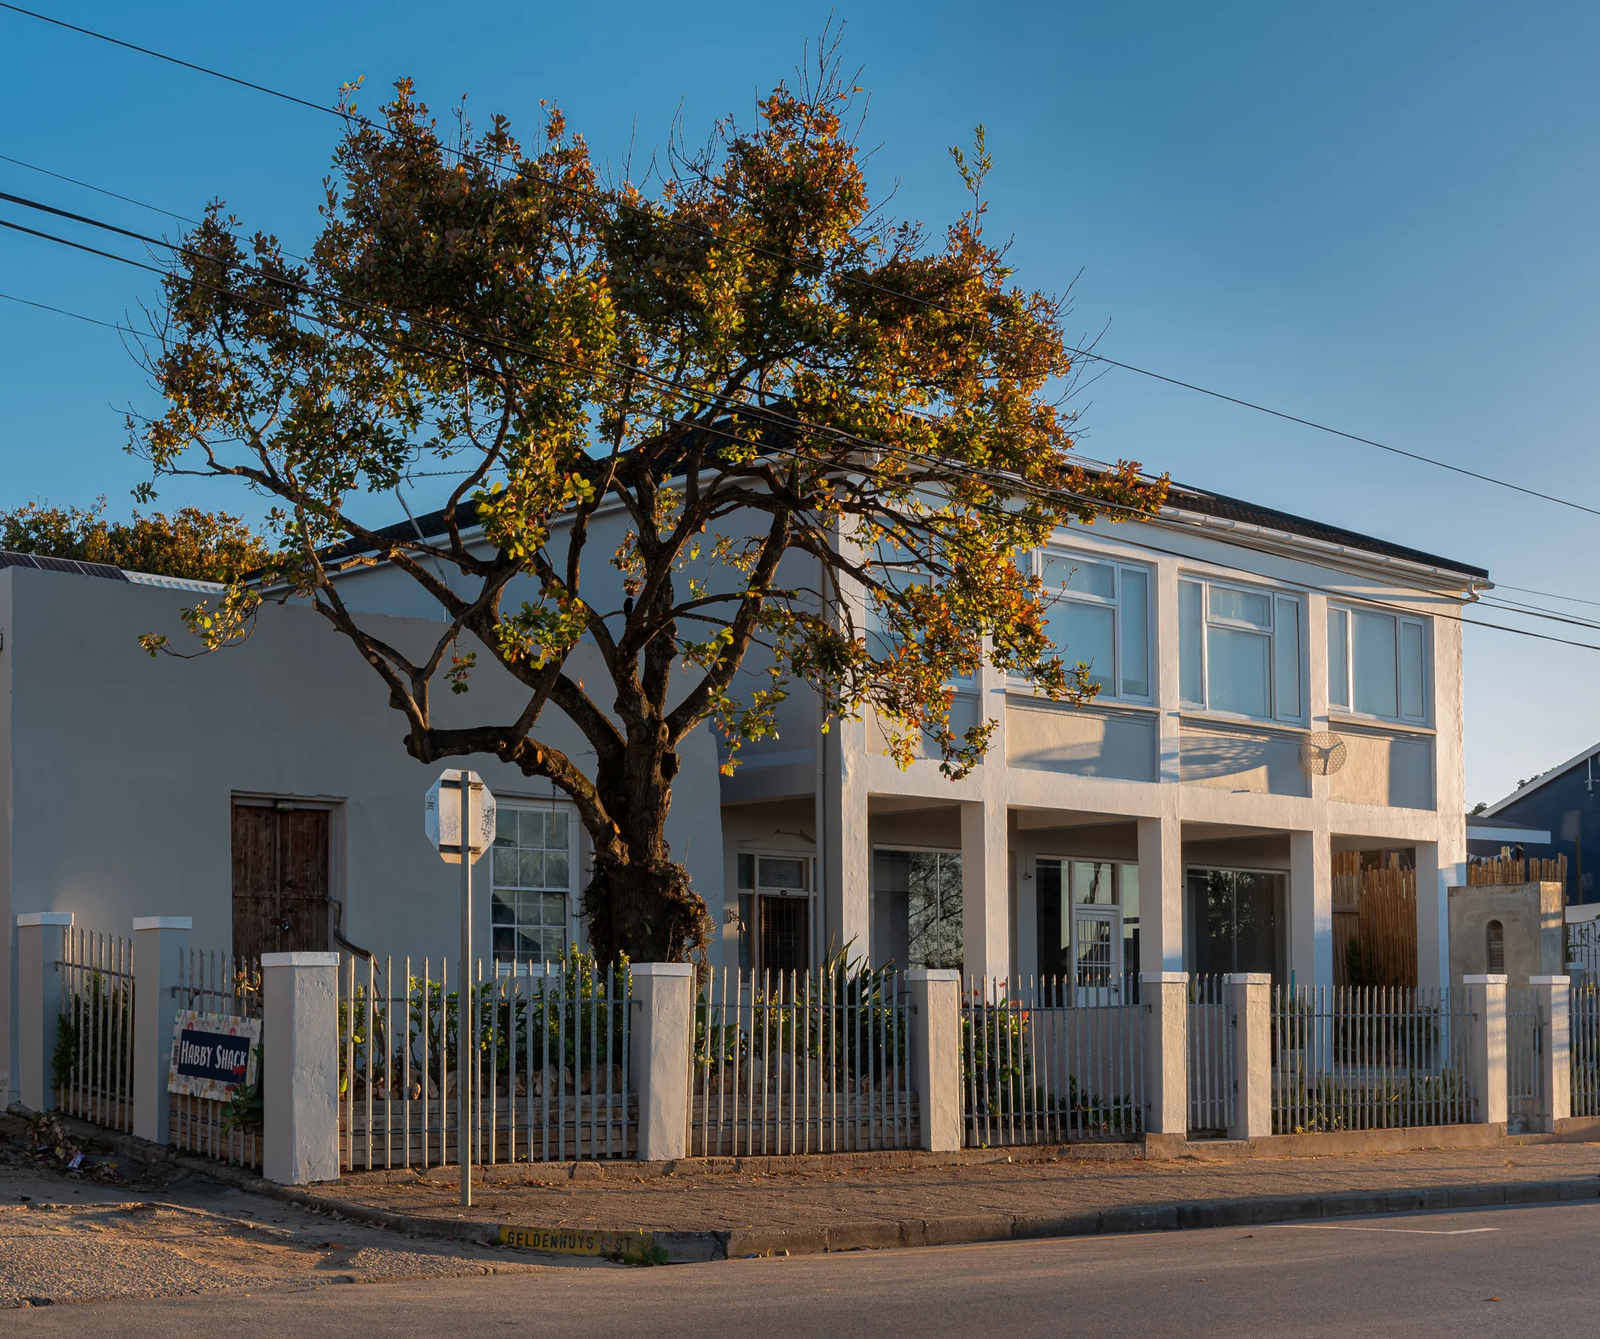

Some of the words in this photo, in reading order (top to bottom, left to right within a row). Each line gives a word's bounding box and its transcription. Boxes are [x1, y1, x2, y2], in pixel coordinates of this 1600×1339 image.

[181, 1040, 213, 1068] HABBY
[507, 1231, 594, 1250] GELDENHUYS
[615, 1236, 632, 1251] ST
